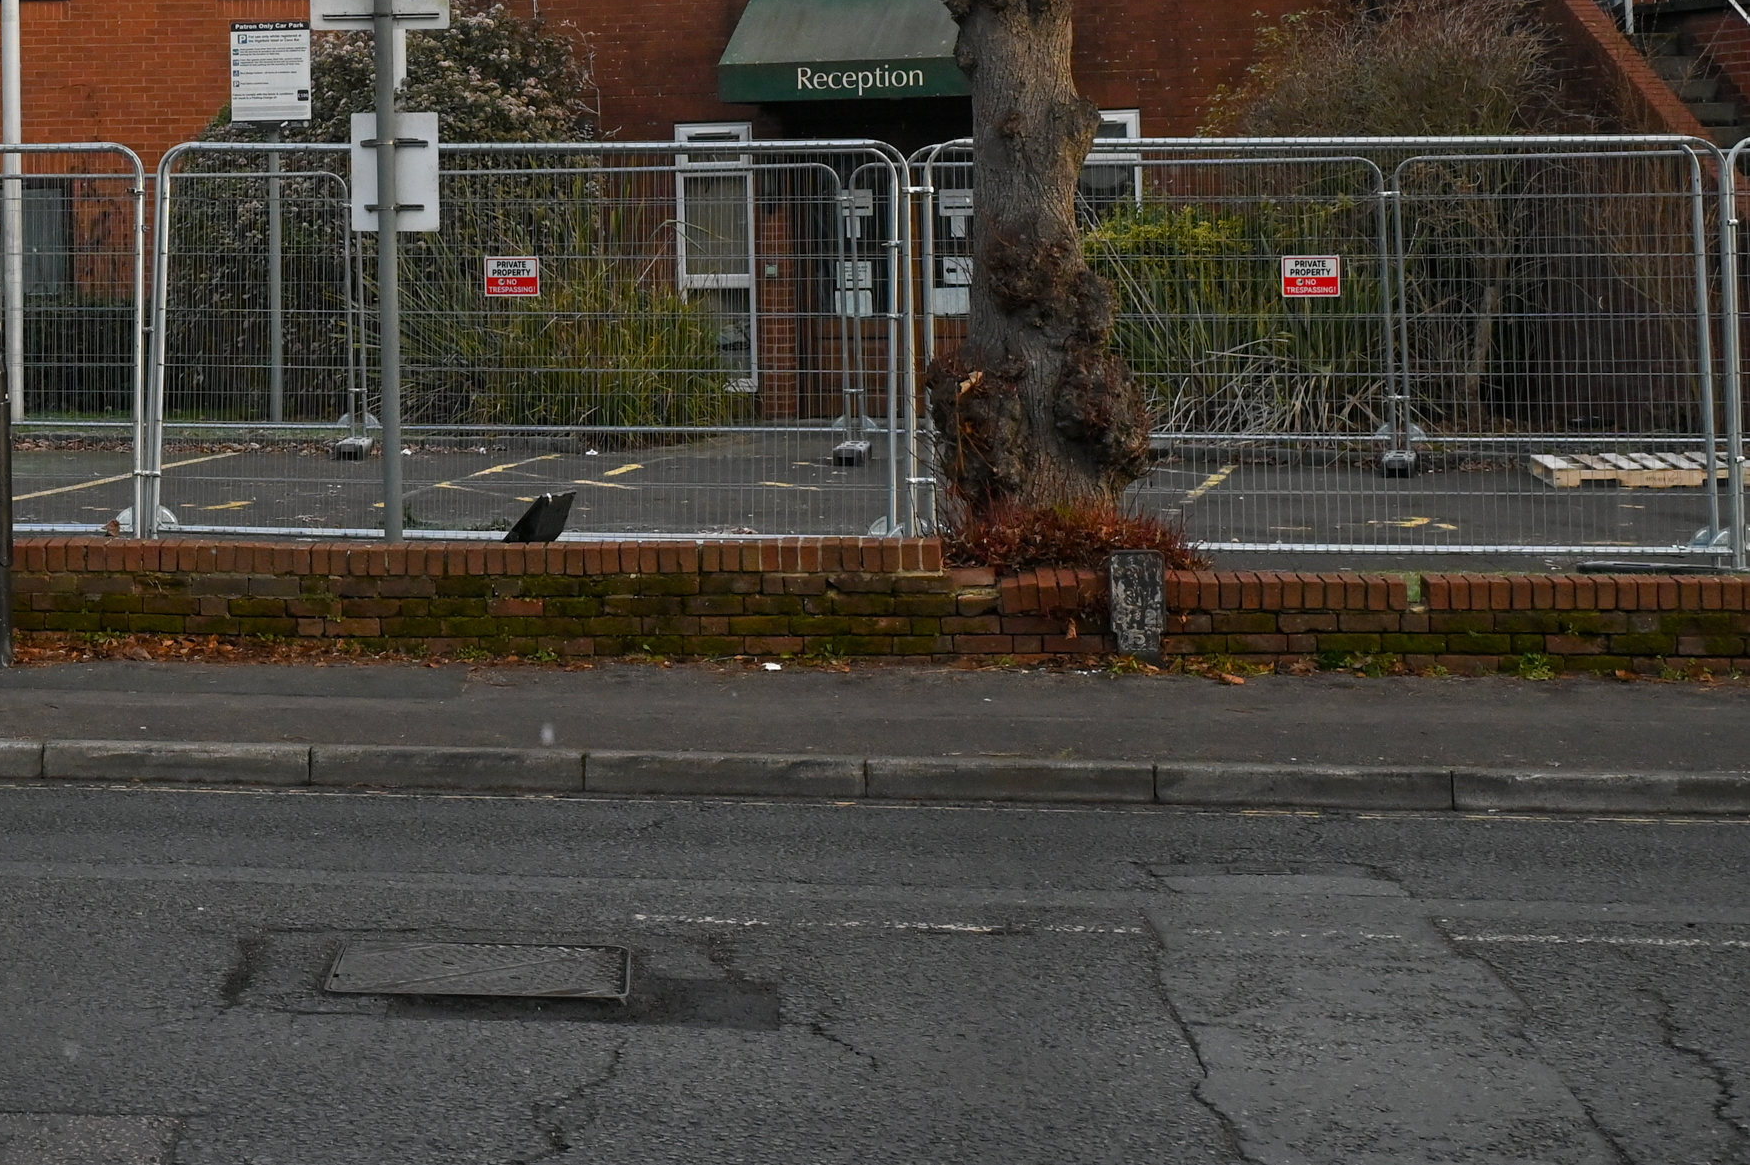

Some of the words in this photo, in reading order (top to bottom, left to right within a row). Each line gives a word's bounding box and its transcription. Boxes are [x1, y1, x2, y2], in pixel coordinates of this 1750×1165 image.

[797, 64, 924, 96] Reception
[1295, 260, 1326, 268] PRIVATE
[1290, 268, 1331, 276] PROPERTY
